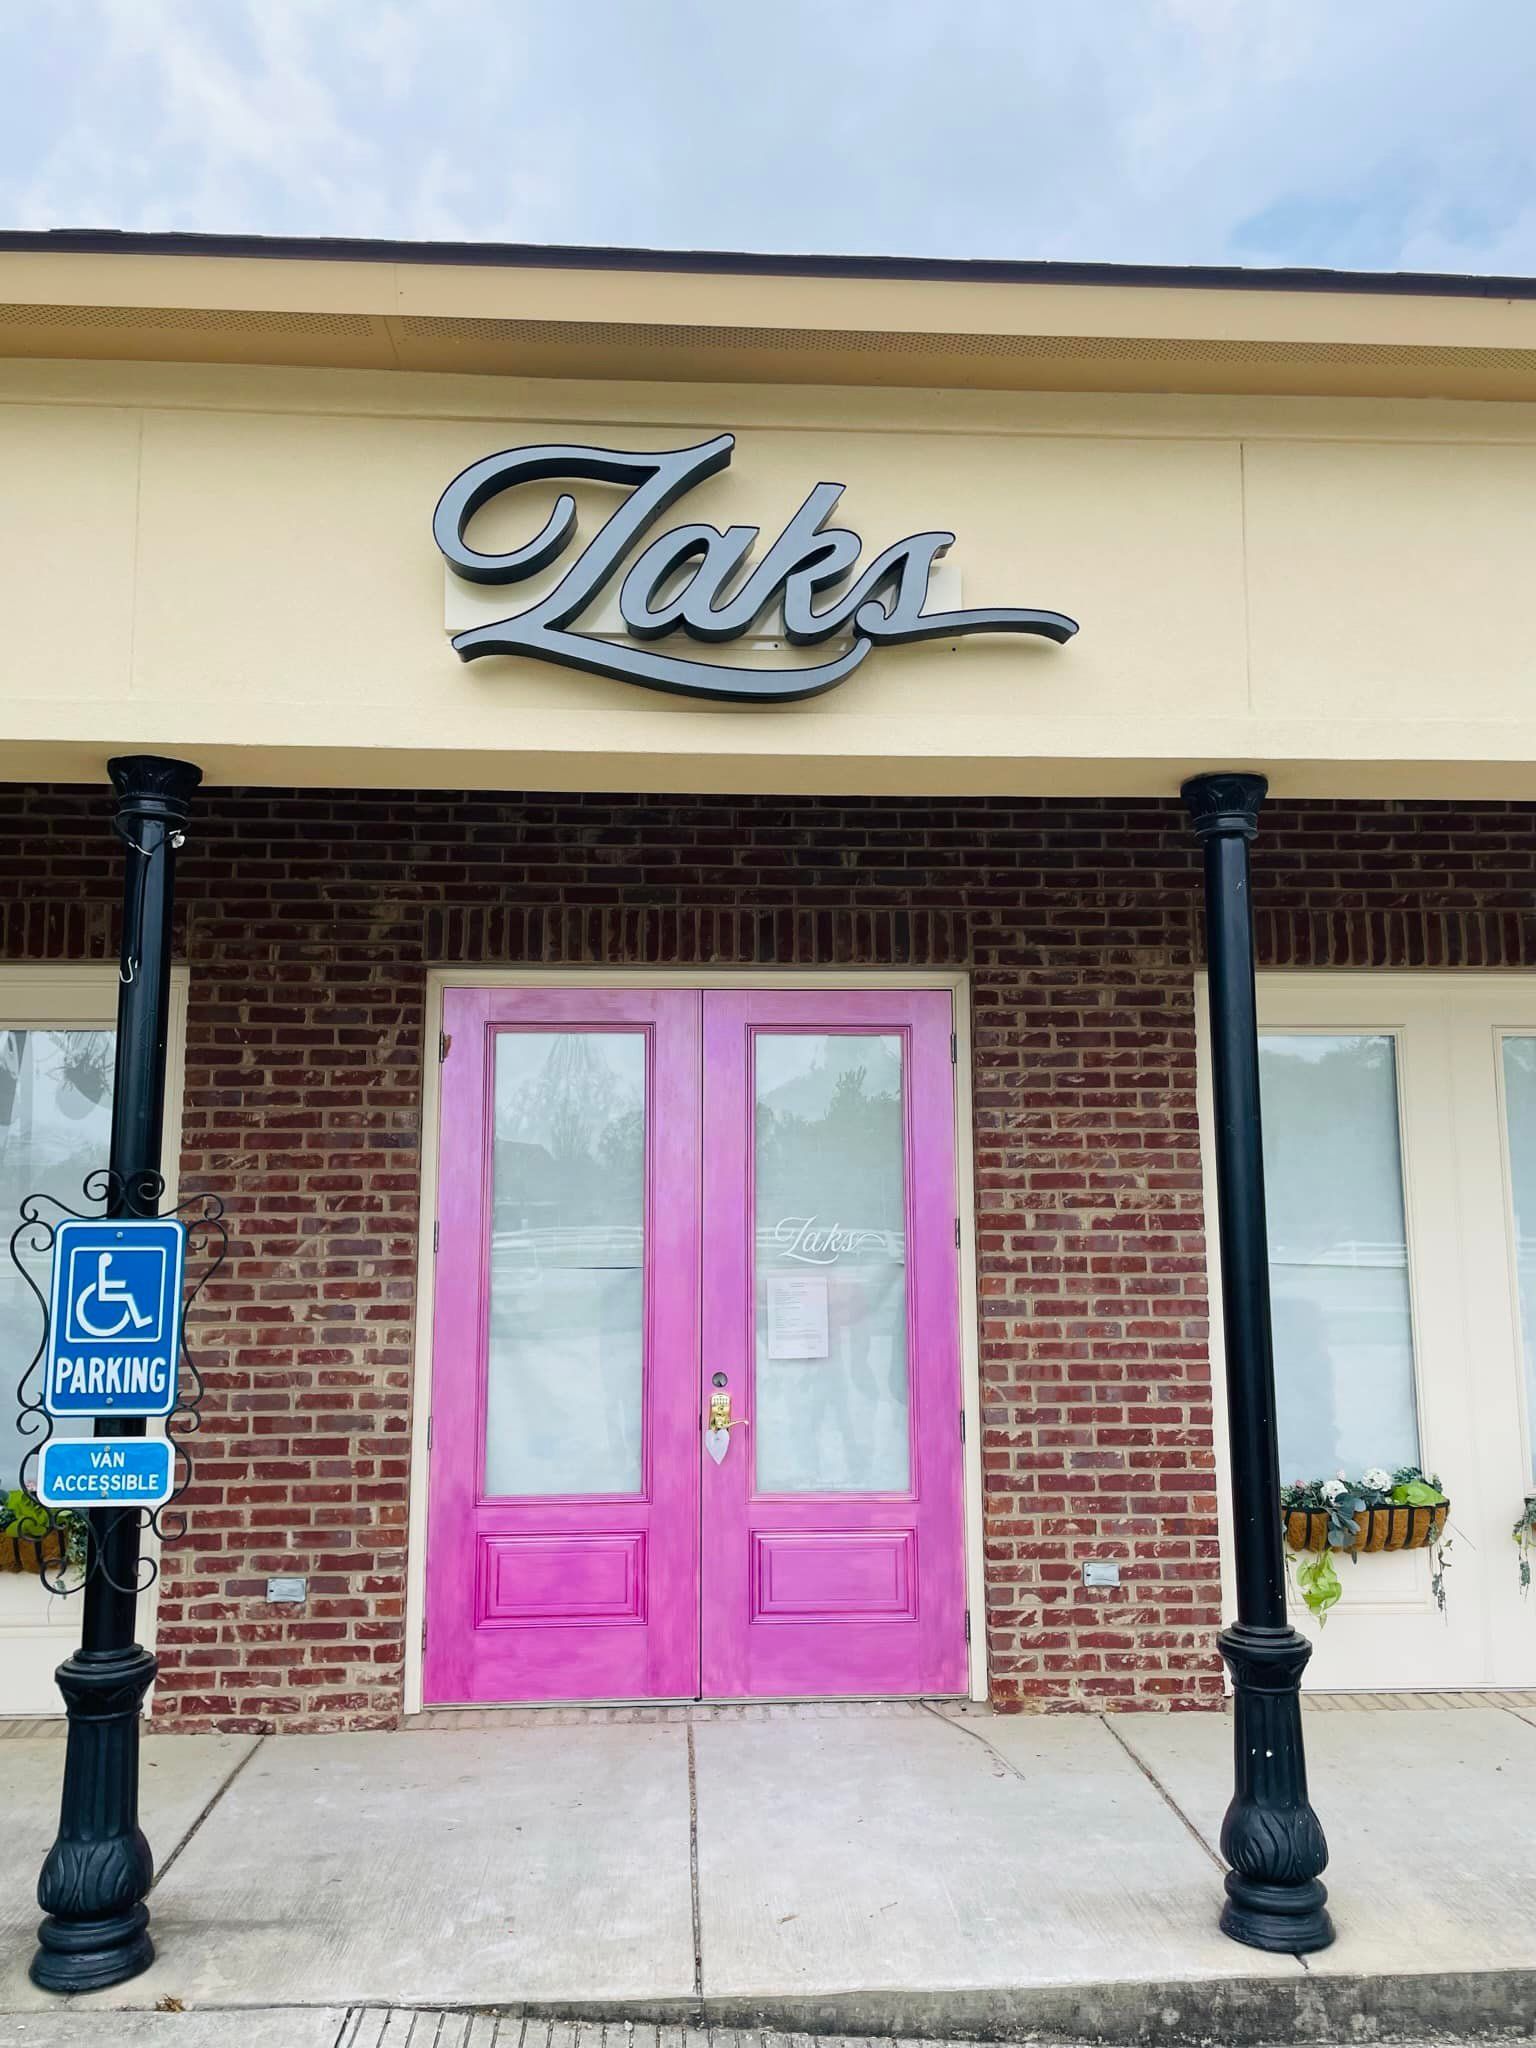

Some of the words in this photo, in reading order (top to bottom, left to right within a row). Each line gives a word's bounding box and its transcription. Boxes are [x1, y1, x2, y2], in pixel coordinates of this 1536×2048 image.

[433, 433, 1080, 703] Zaks
[775, 1215, 885, 1264] Zaks
[55, 1357, 166, 1393] PARKING
[90, 1452, 125, 1468] VAN
[53, 1474, 159, 1491] ACCESSIBLE
